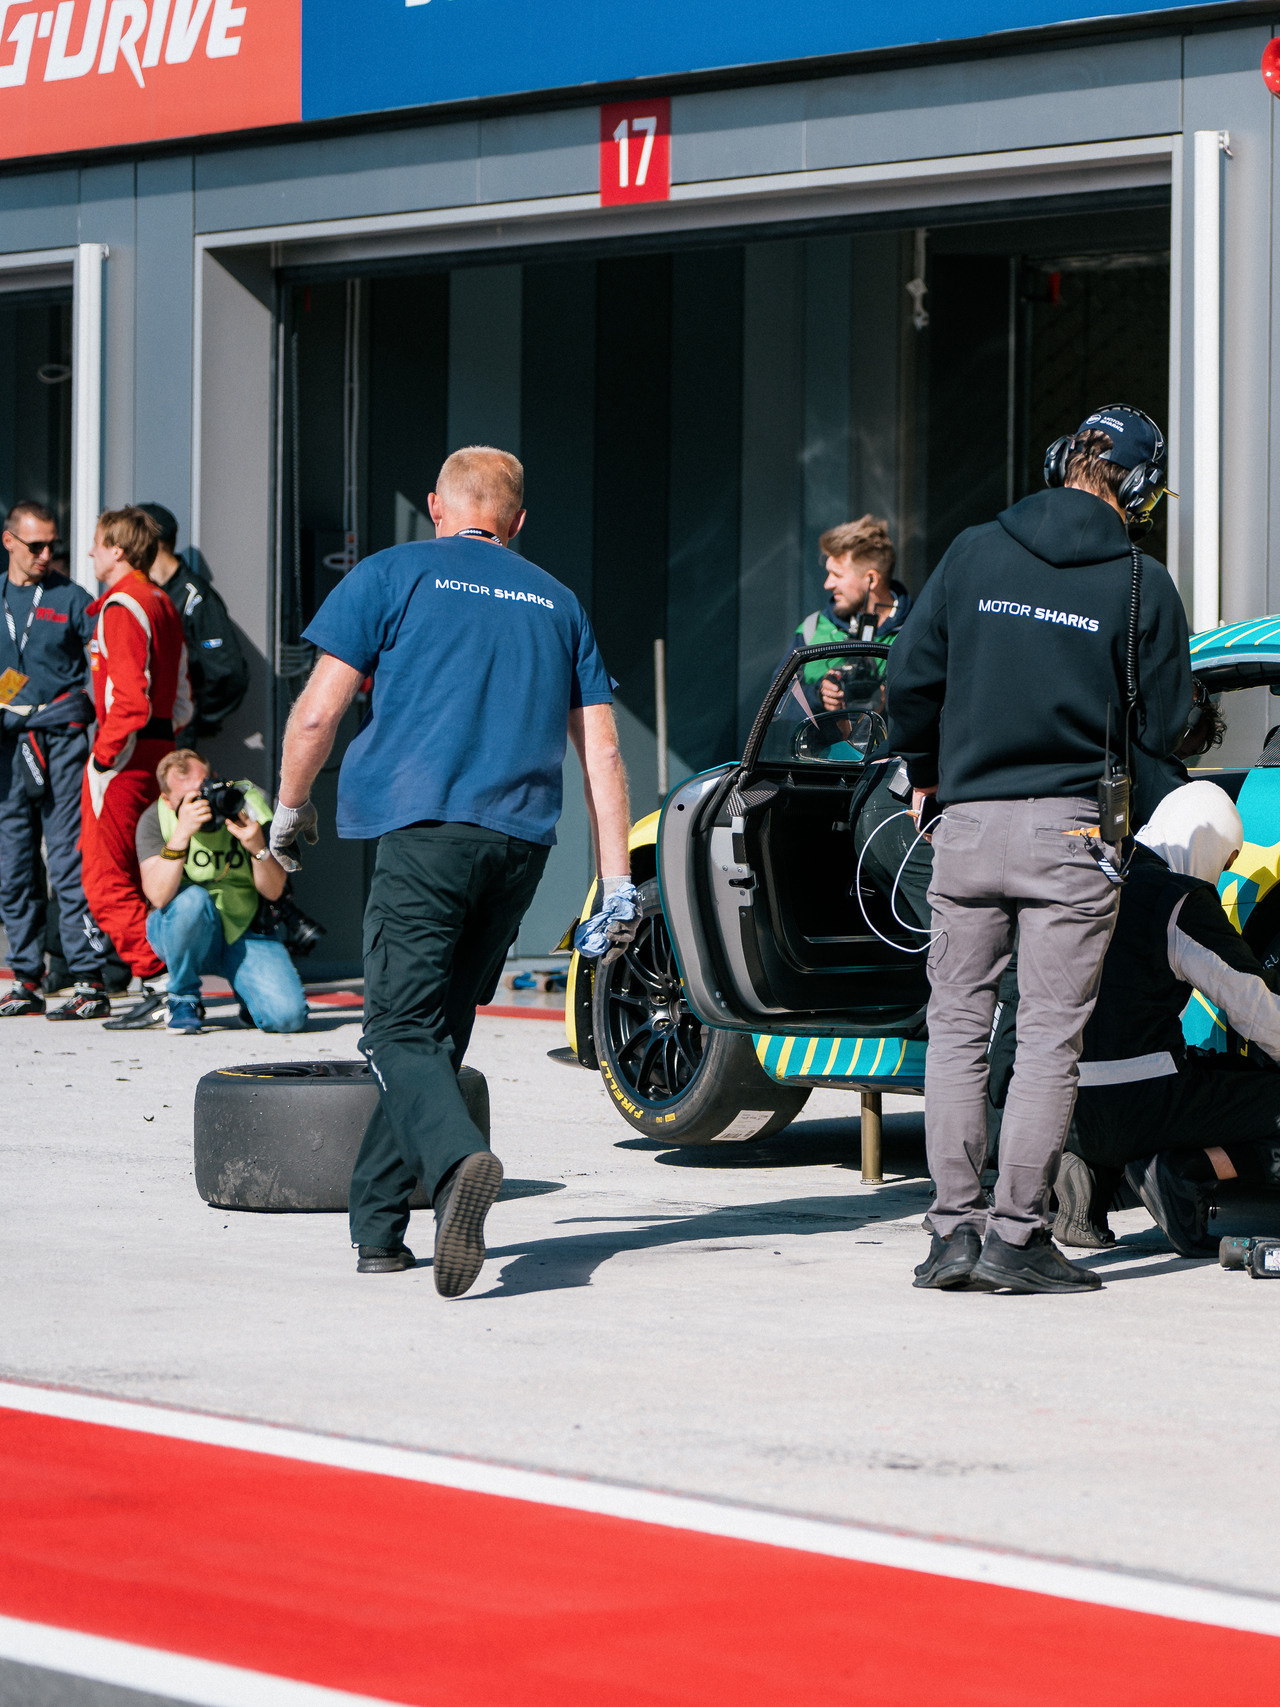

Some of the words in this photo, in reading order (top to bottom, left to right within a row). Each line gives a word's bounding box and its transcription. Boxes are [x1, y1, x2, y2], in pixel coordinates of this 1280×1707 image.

[612, 116, 657, 188] 17
[435, 578, 491, 596] MOTOR
[494, 588, 555, 609] SHARKS
[978, 598, 1032, 617] MOTOR
[1034, 607, 1100, 632] SHARKS
[193, 850, 244, 869] OTO
[600, 1060, 644, 1119] PIRELLI
